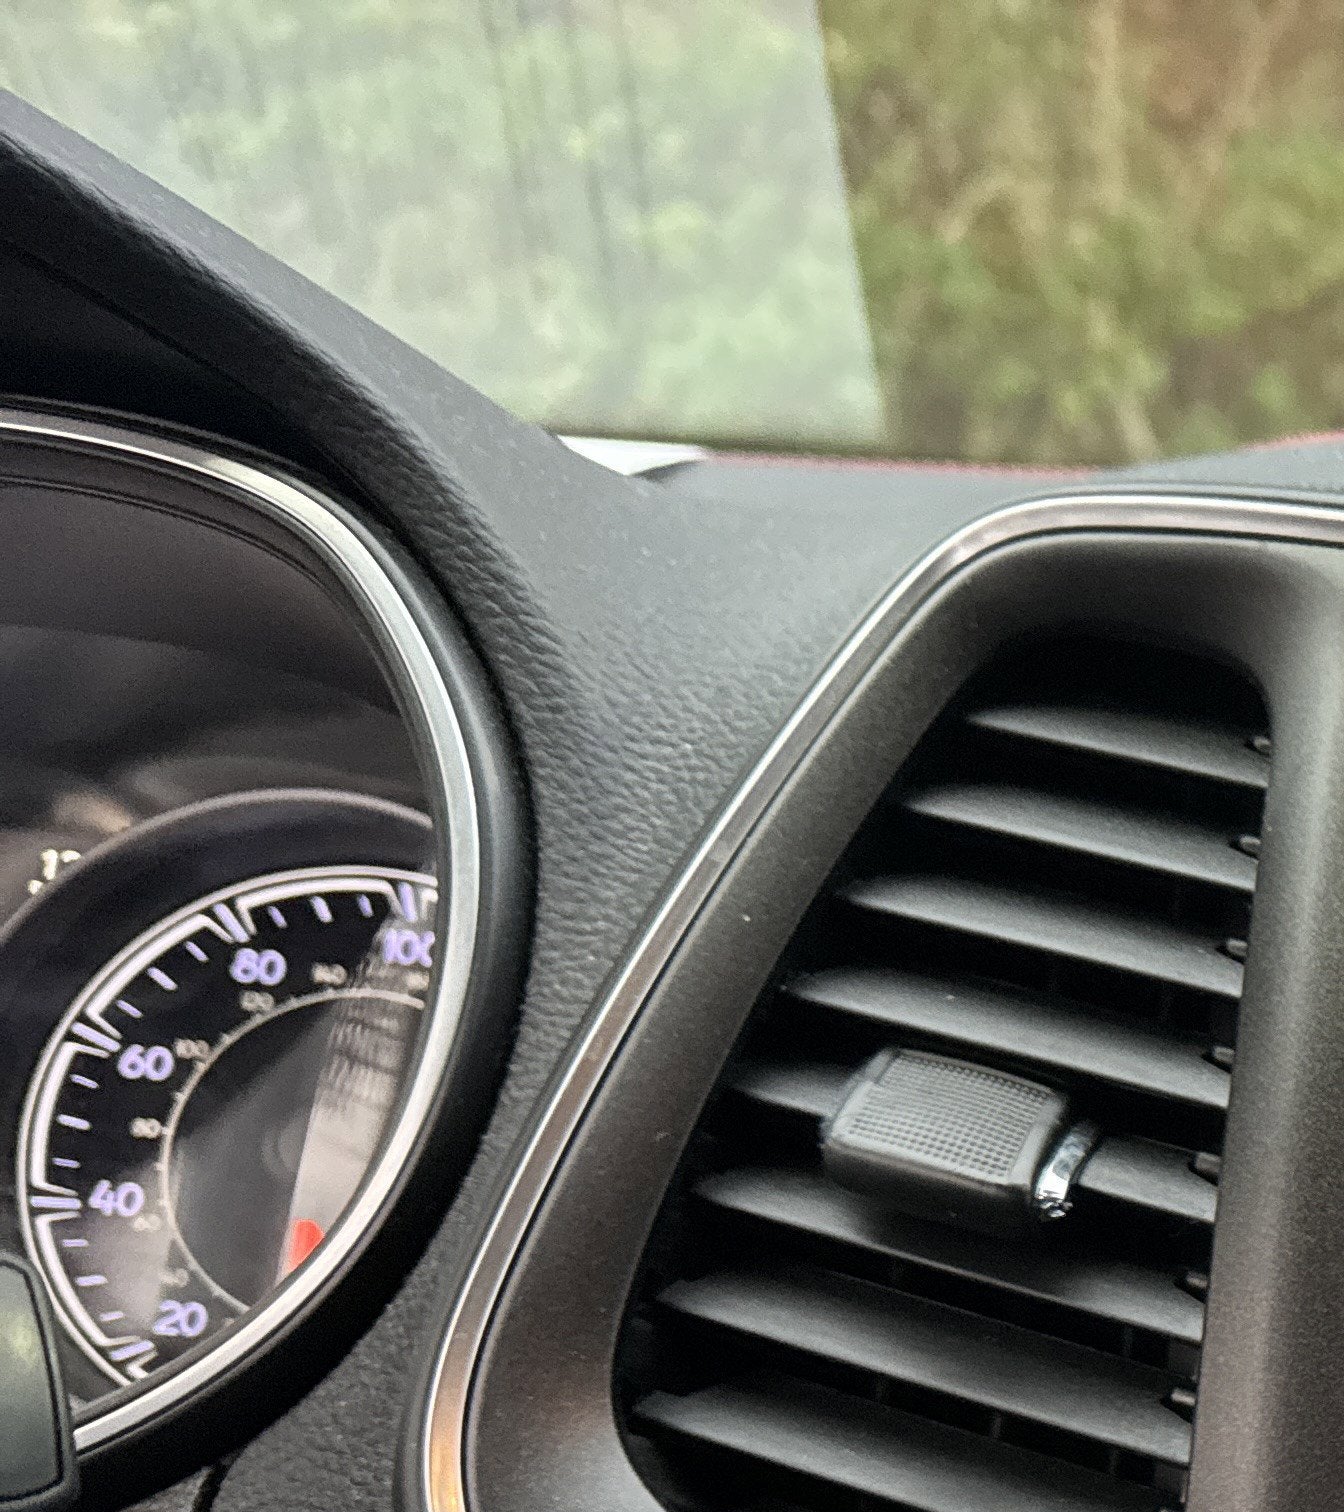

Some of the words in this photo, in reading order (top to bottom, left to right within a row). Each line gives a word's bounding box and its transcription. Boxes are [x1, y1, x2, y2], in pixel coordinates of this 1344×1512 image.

[229, 947, 288, 986] 80
[116, 1043, 173, 1081] 60
[88, 1179, 146, 1217] 40
[152, 1298, 208, 1338] 20
